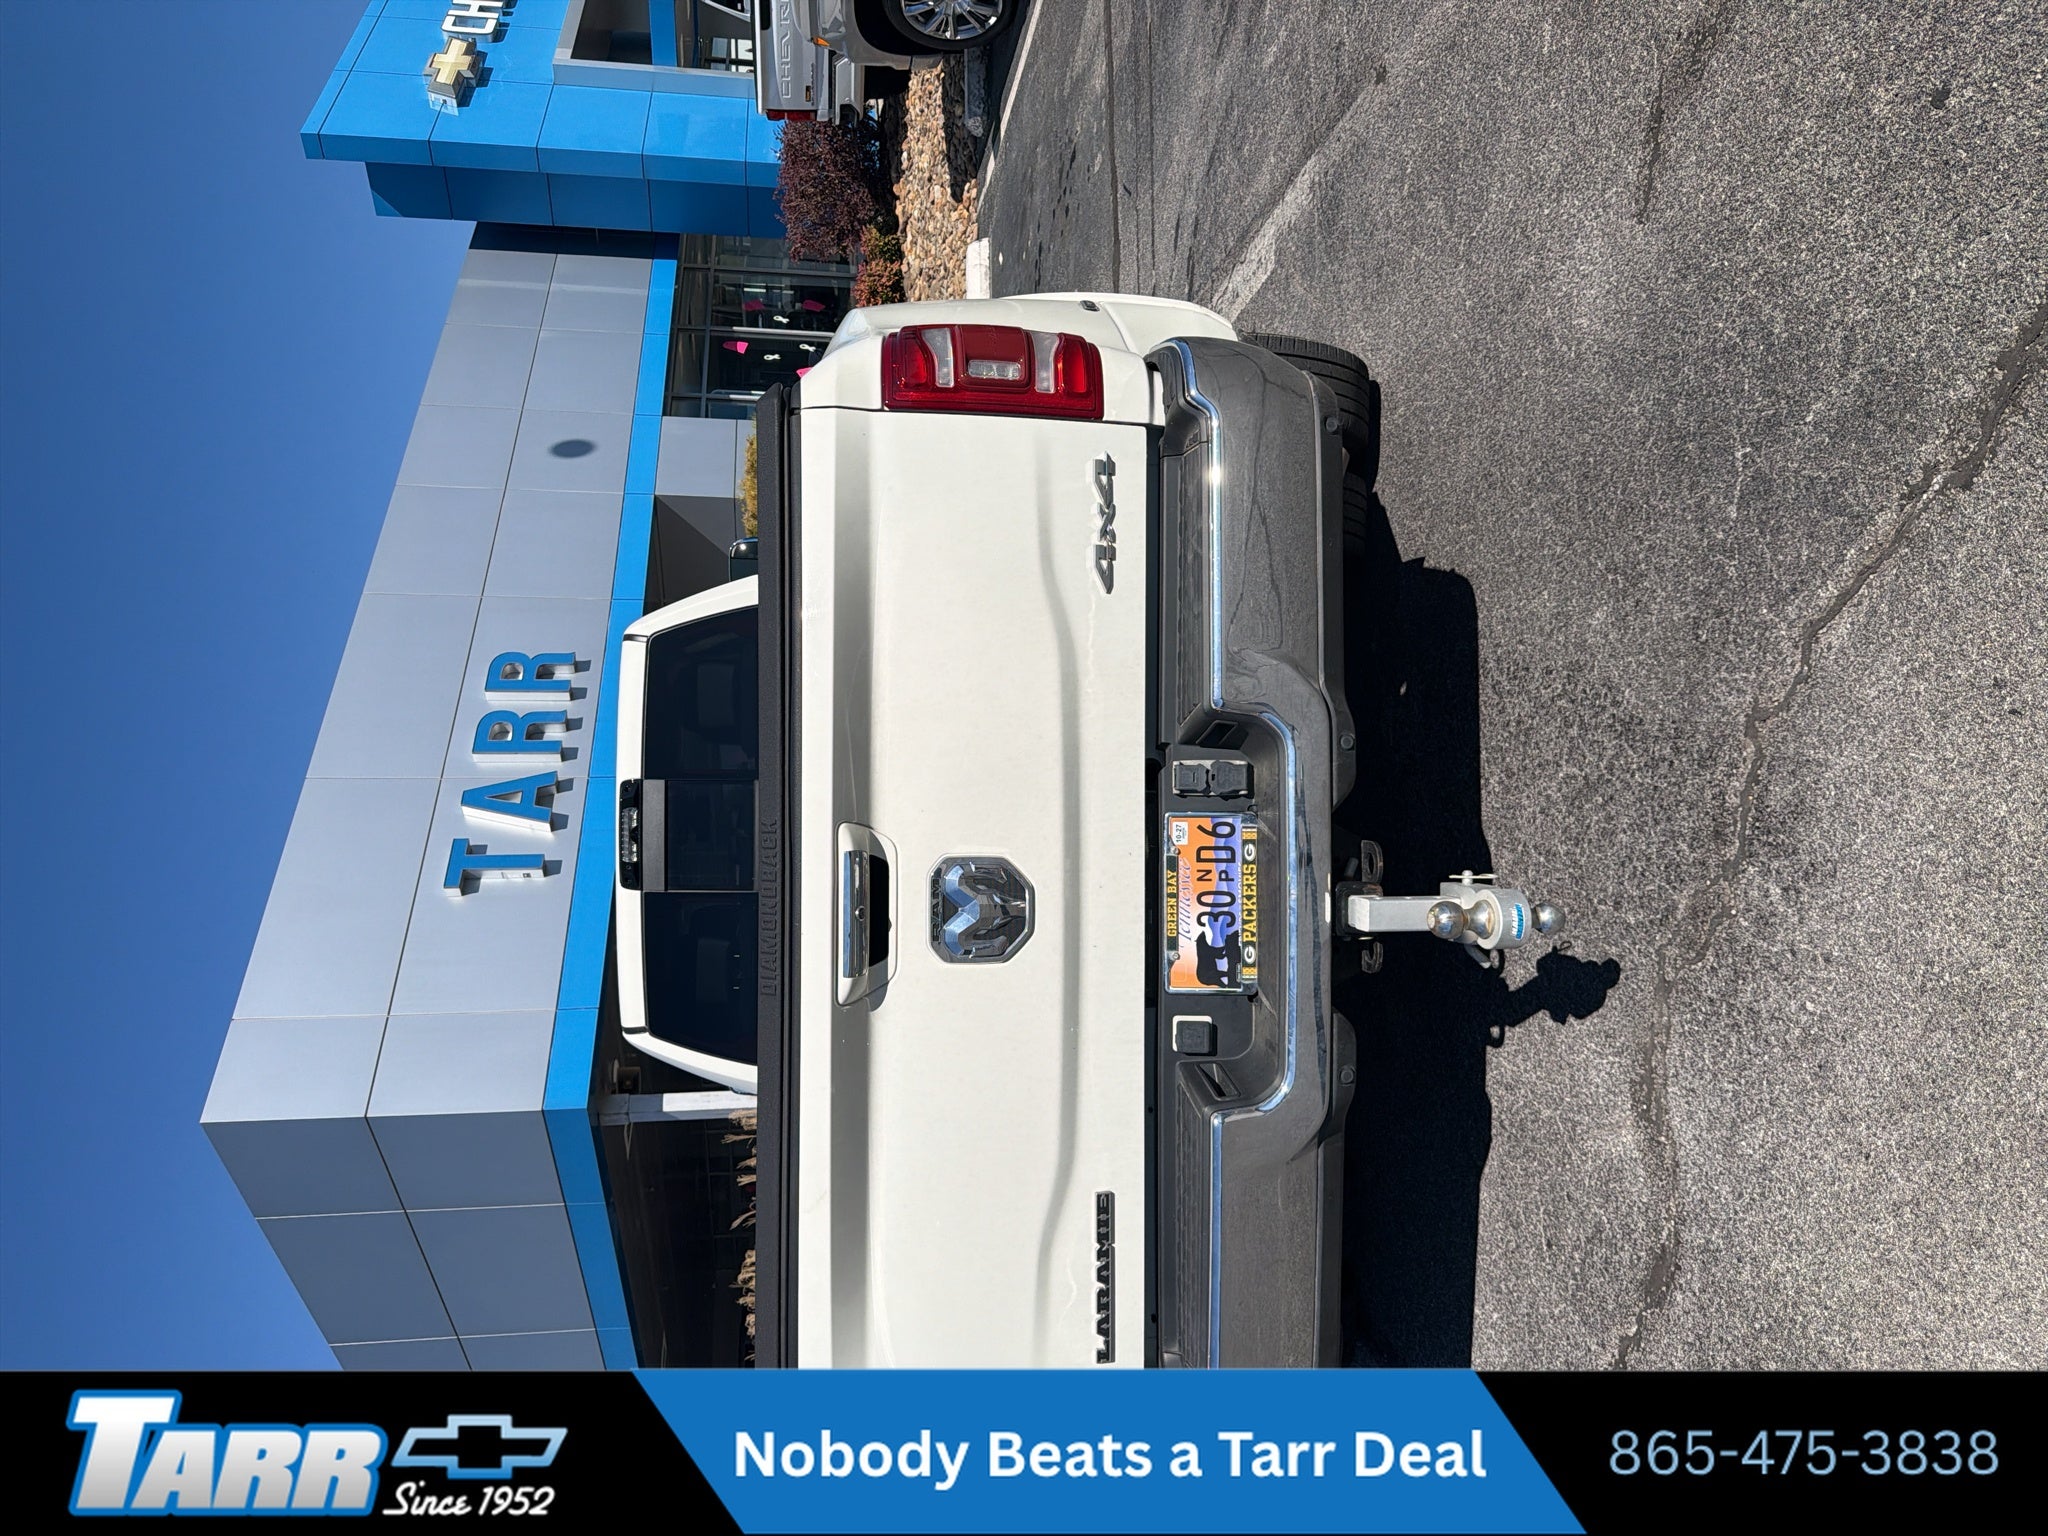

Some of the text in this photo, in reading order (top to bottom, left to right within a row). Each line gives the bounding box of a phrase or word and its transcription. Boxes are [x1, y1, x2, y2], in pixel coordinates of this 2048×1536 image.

[780, 0, 791, 98] CHEVR
[443, 652, 576, 890] TARR
[760, 819, 777, 996] DIAMONDBACK
[931, 878, 941, 943] RAM
[1167, 869, 1177, 937] GREEN BAY
[1178, 857, 1191, 941] Tennessee
[1243, 864, 1257, 942] PACKERS
[1096, 1191, 1115, 1364] LARAMIE
